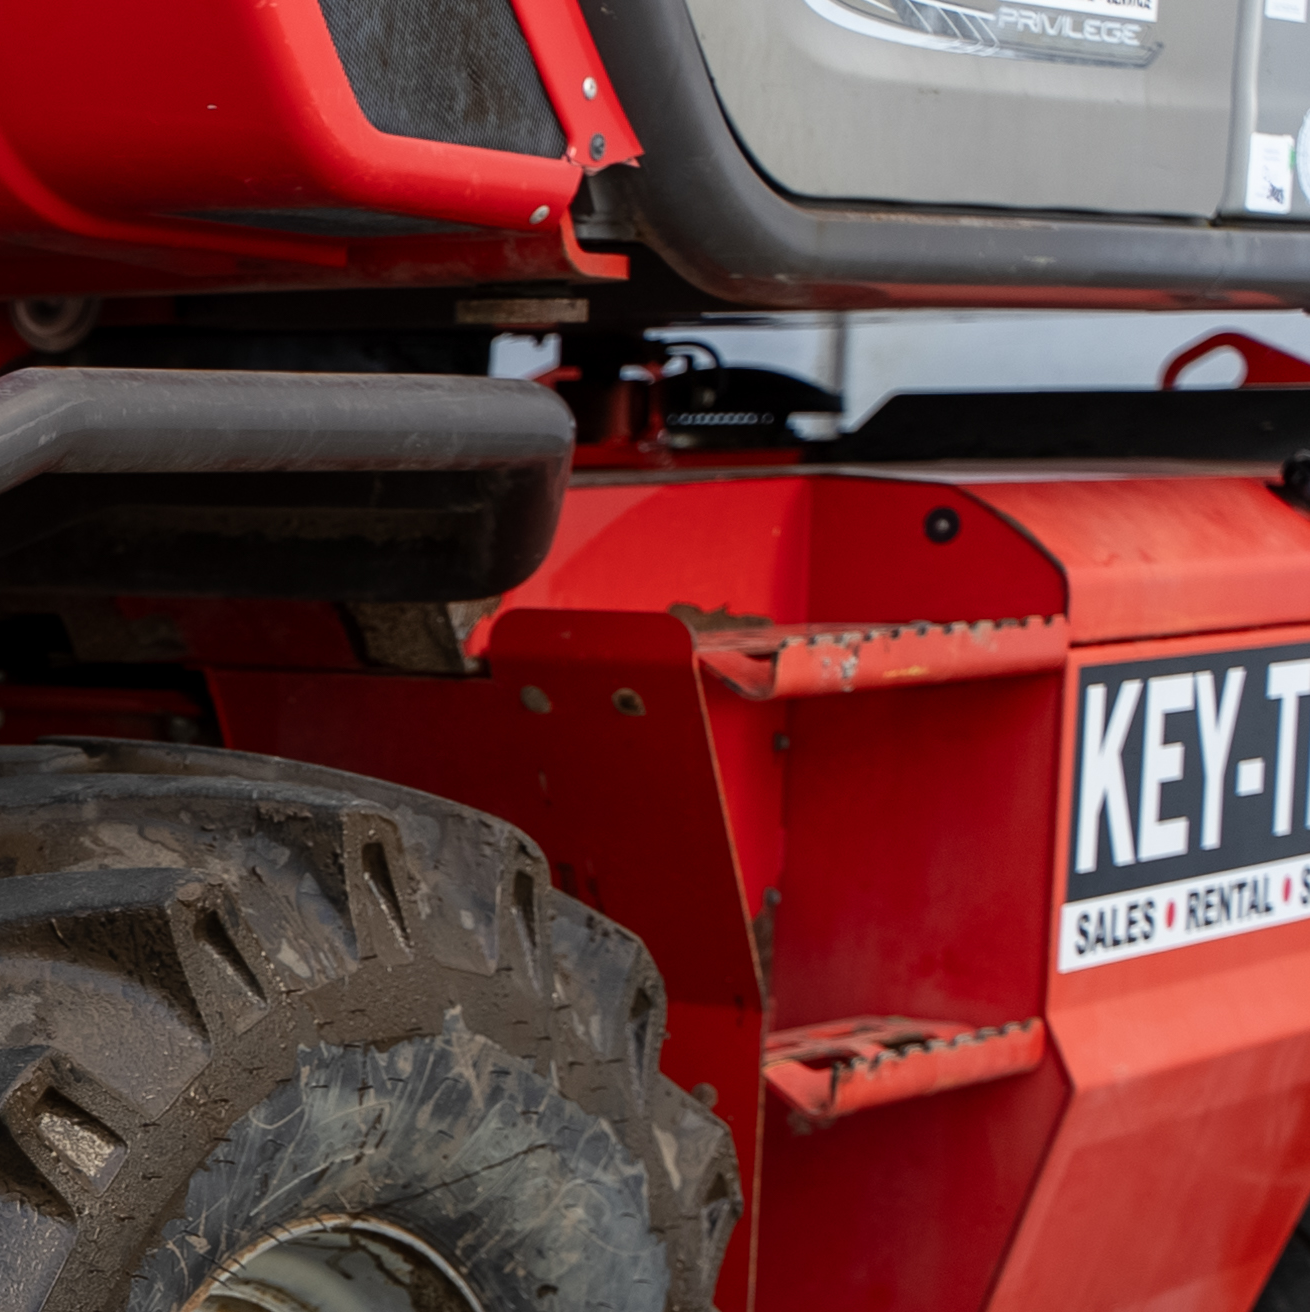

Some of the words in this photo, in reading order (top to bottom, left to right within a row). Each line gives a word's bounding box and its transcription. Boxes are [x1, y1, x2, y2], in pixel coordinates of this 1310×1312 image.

[996, 5, 1144, 47] PRIVILEGE
[1074, 657, 1310, 875] KEY-T
[1074, 896, 1156, 956] SALES
[1185, 873, 1273, 931] RENTAL
